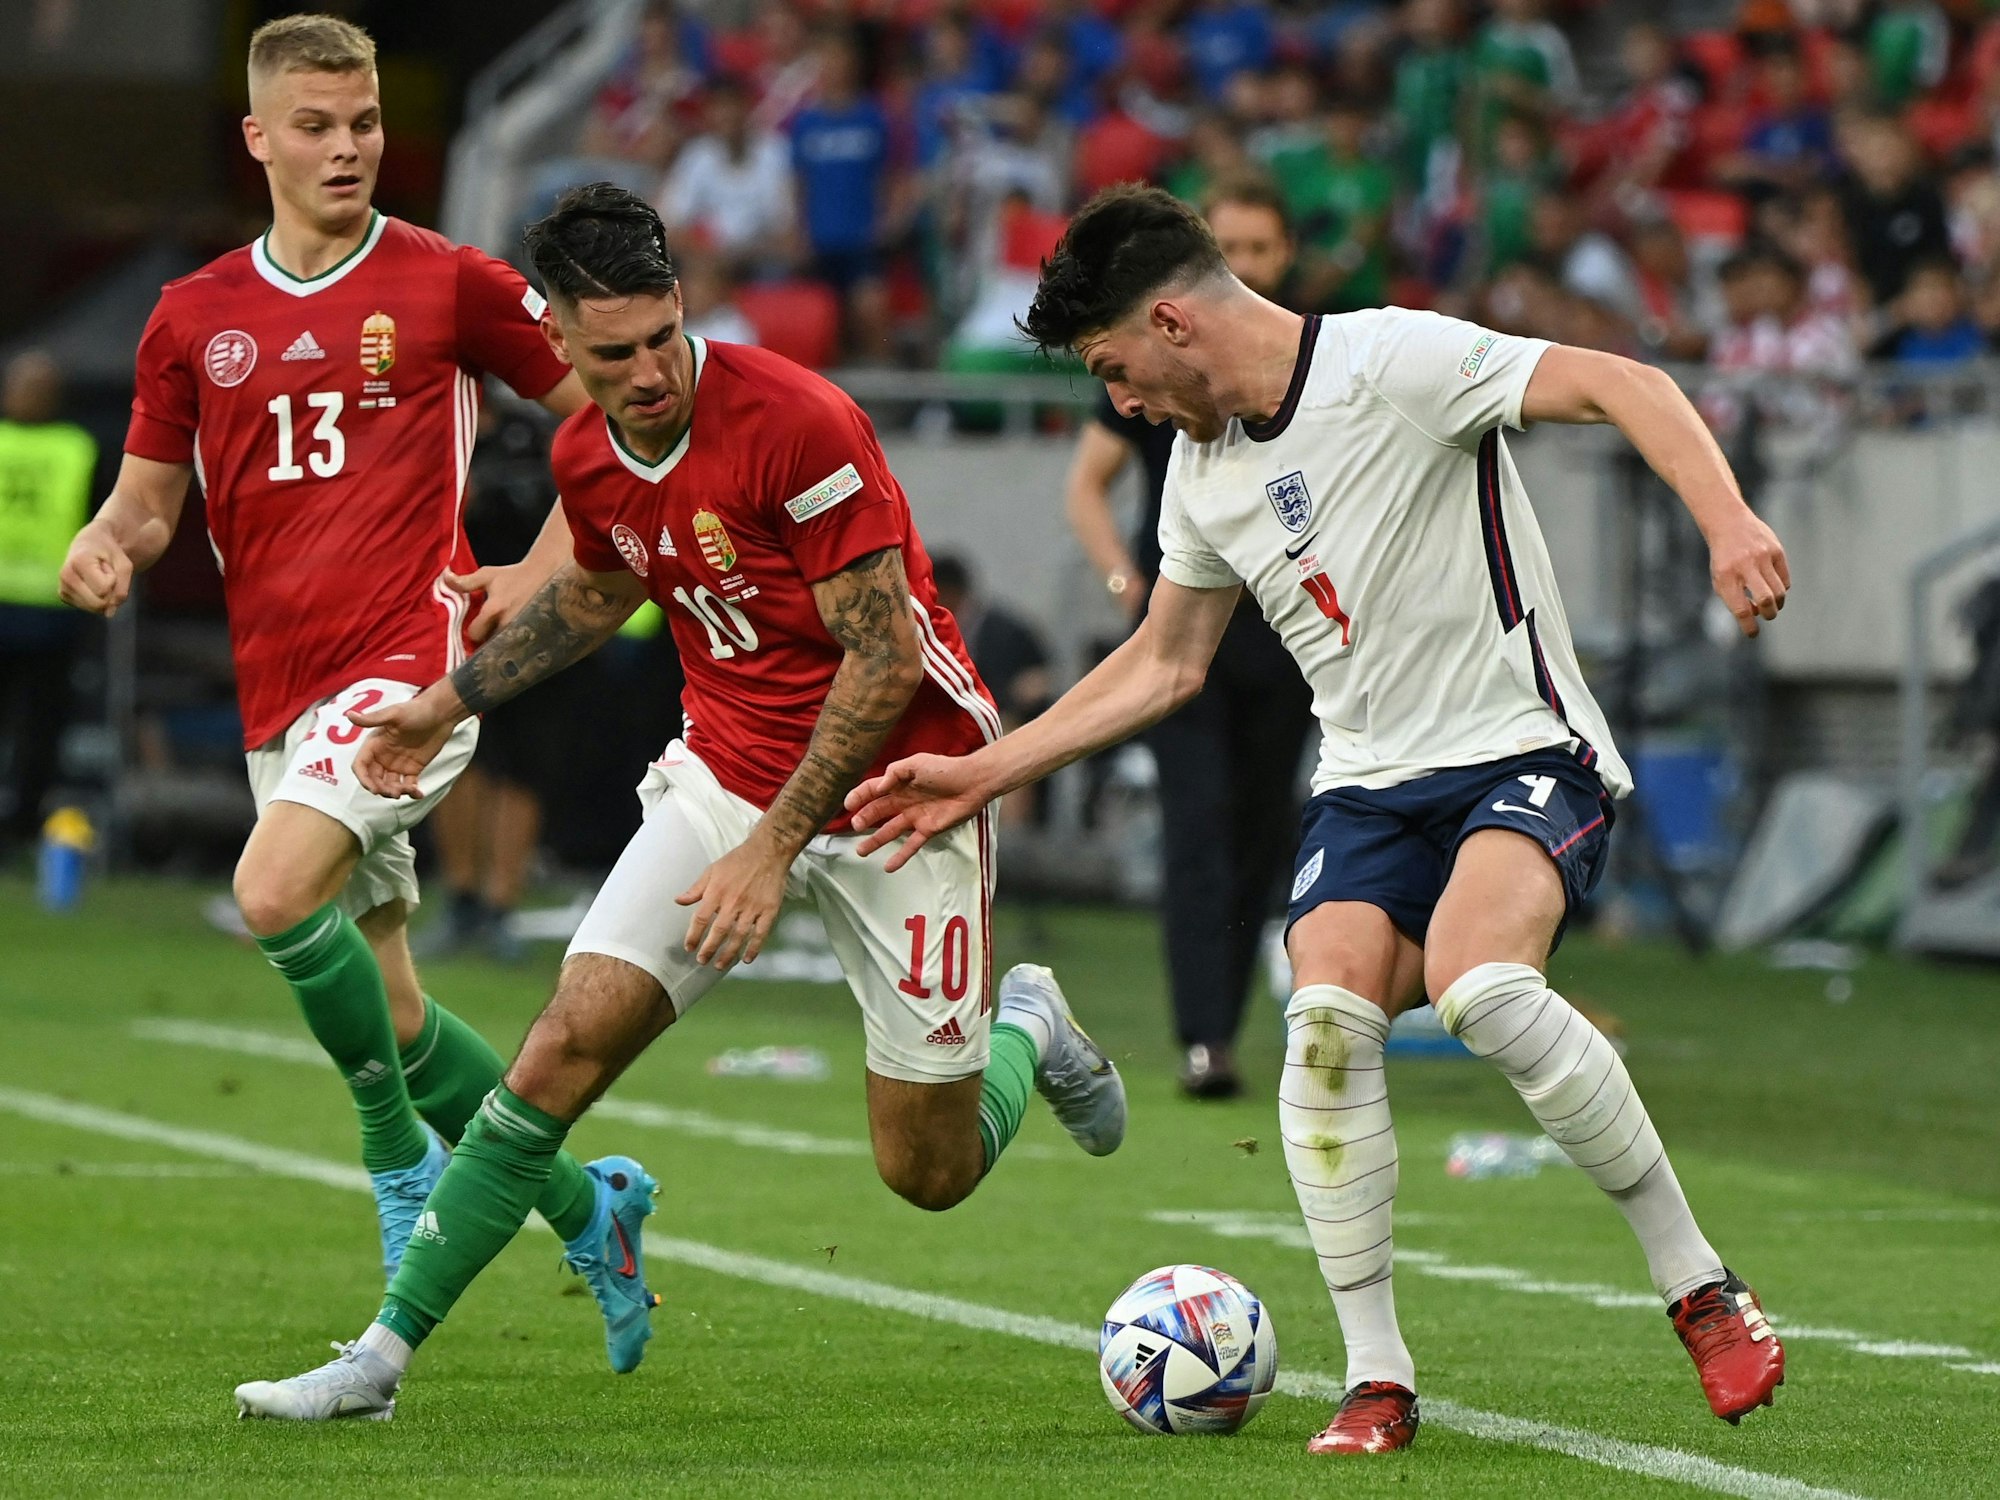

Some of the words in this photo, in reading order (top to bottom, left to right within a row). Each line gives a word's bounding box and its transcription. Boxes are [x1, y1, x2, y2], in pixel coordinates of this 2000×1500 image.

[281, 349, 325, 361] adidas
[268, 391, 345, 481] 13
[790, 471, 858, 515] FOUNDATION
[672, 584, 759, 660] 10
[1300, 572, 1350, 646] 4
[898, 914, 969, 1001] 10
[926, 1034, 966, 1045] adidas
